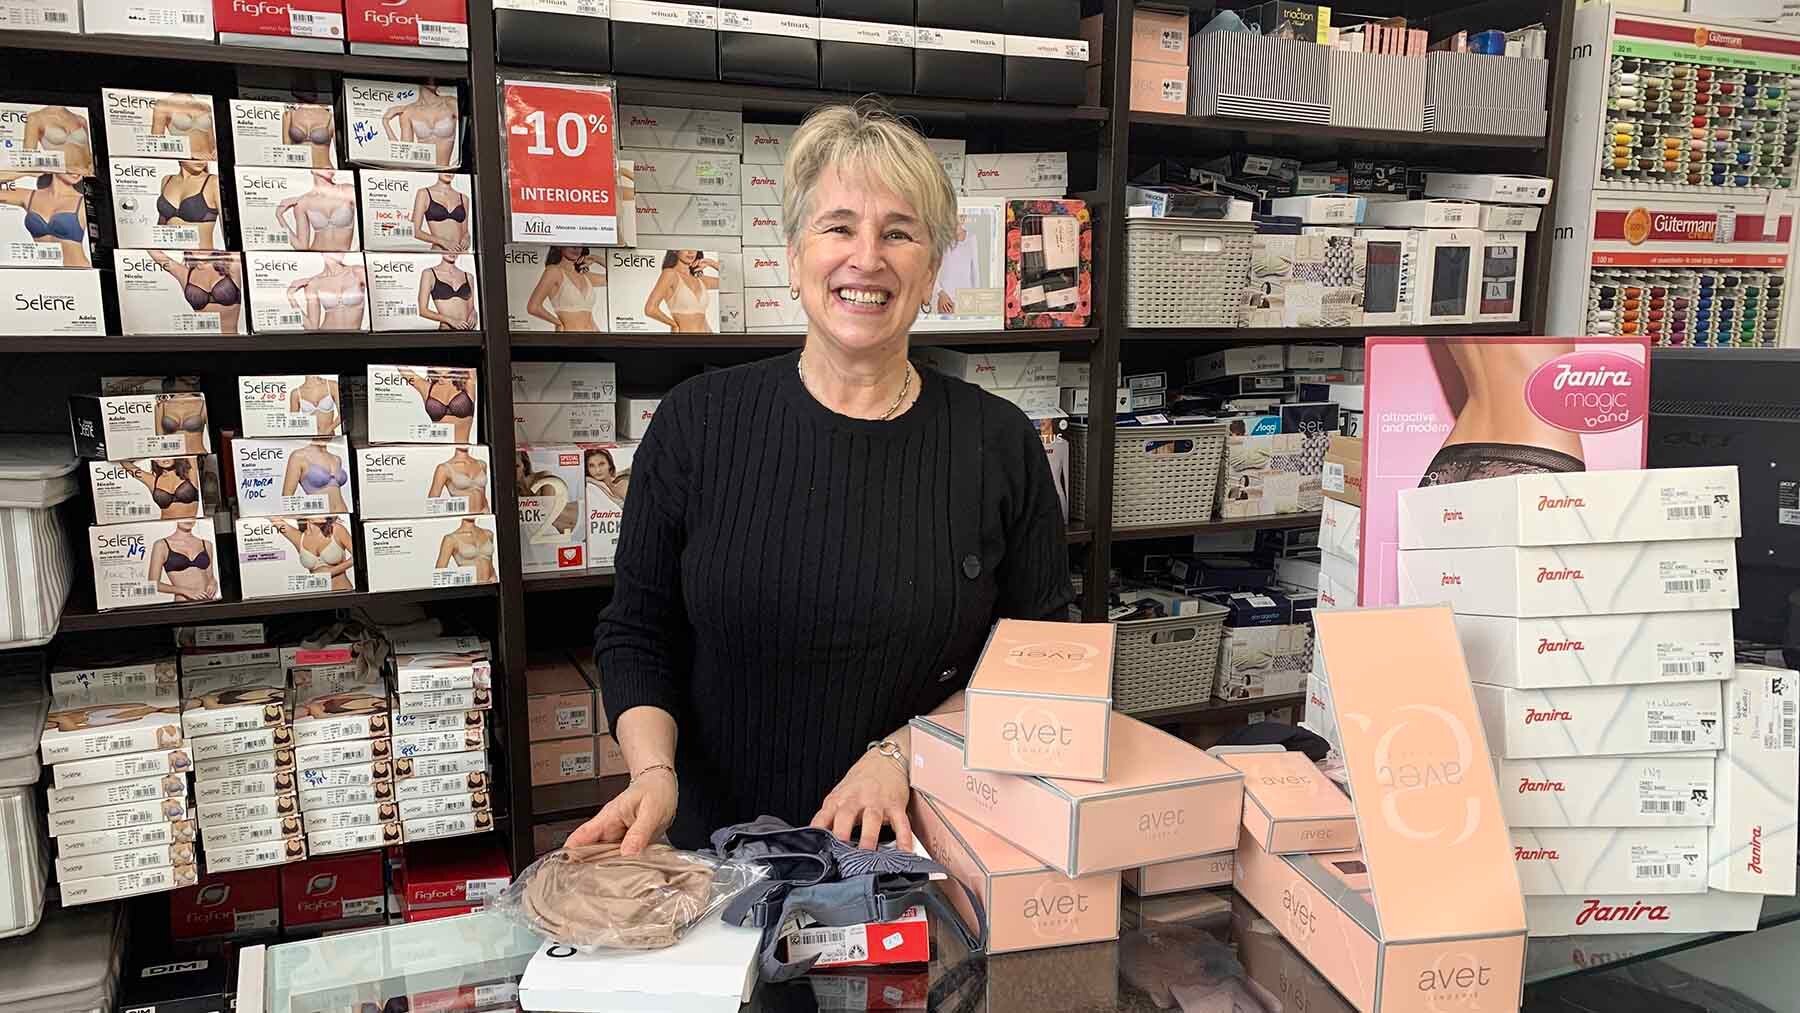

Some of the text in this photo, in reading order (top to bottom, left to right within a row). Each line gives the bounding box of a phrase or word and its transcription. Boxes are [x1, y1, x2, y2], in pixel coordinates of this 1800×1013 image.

[232, 0, 294, 16] figfort
[364, 10, 422, 25] figfort
[1709, 31, 1743, 47] Gütermann
[108, 93, 156, 108] Selene
[352, 86, 394, 102] Selene
[236, 104, 281, 121] Selene
[630, 117, 658, 127] Janira
[754, 136, 779, 145] Janira
[114, 164, 157, 178] Selene
[977, 168, 1000, 178] Janira
[243, 175, 288, 189] Selene
[368, 177, 409, 192] Selene
[751, 176, 777, 186] Janira
[521, 187, 609, 204] INTERIORES
[525, 219, 552, 234] Mila
[752, 217, 778, 227] Janira
[123, 258, 170, 272] Selene
[254, 259, 298, 272] Selene
[506, 252, 538, 265] elene
[614, 252, 656, 268] Selene
[755, 259, 779, 268] Janira
[373, 260, 415, 273] Selene
[1399, 253, 1410, 303] PRIVATA
[15, 294, 76, 311] Selene
[755, 299, 780, 309] Janira
[374, 372, 415, 386] Selene
[1554, 364, 1632, 391] Janira
[243, 380, 288, 394] Selene
[106, 401, 153, 415] Selene
[1564, 392, 1628, 414] magic
[1298, 420, 1324, 432] set
[1584, 410, 1628, 428] band
[1256, 421, 1276, 434] sloggi
[1382, 422, 1449, 433] and modern
[239, 447, 284, 461] Selene
[365, 453, 407, 467] Selene
[95, 467, 143, 481] Selene
[1538, 495, 1586, 512] Janira
[590, 509, 622, 520] Janira
[1443, 508, 1464, 523] Janira
[243, 523, 286, 537] Selene
[372, 527, 414, 540] Selene
[97, 535, 144, 548] Selene
[1442, 572, 1462, 586] Janira
[1536, 566, 1584, 583] Janira
[1538, 638, 1584, 654] Janira
[1524, 708, 1572, 725] Janira
[1001, 720, 1073, 746] avet
[1260, 773, 1312, 786] avet
[1378, 761, 1464, 788] avet
[966, 774, 999, 806] avet
[1518, 778, 1566, 794] Janira
[1138, 808, 1185, 833] avet
[1300, 829, 1333, 841] avet
[1514, 846, 1560, 862] Janira
[1747, 824, 1762, 874] Janira
[1023, 893, 1090, 919] avet
[1282, 888, 1316, 934] avet
[1575, 899, 1672, 926] Janira
[149, 962, 198, 975] DIM
[1418, 965, 1491, 992] avet
